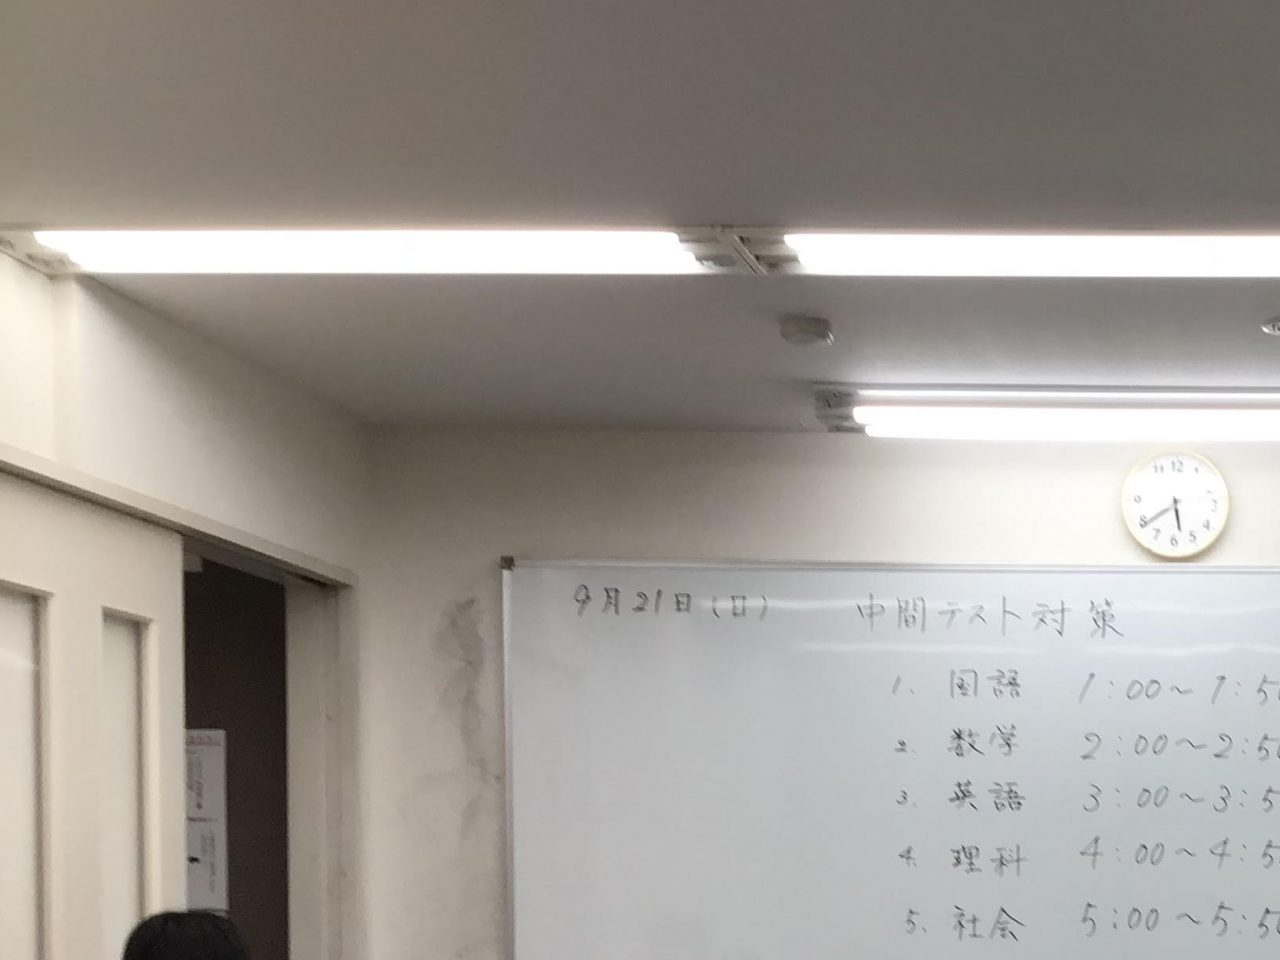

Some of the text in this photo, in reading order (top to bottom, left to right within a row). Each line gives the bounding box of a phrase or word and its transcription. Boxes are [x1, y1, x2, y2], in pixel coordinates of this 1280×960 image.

[1171, 459, 1184, 473] 12
[1169, 534, 1179, 547] 6
[857, 592, 1125, 638] 中間テスト対策
[950, 669, 1021, 699] 国語
[946, 724, 1018, 757] 数学
[949, 779, 1026, 812] 英語
[950, 843, 1028, 877] 理科
[953, 905, 1026, 942] 社会
